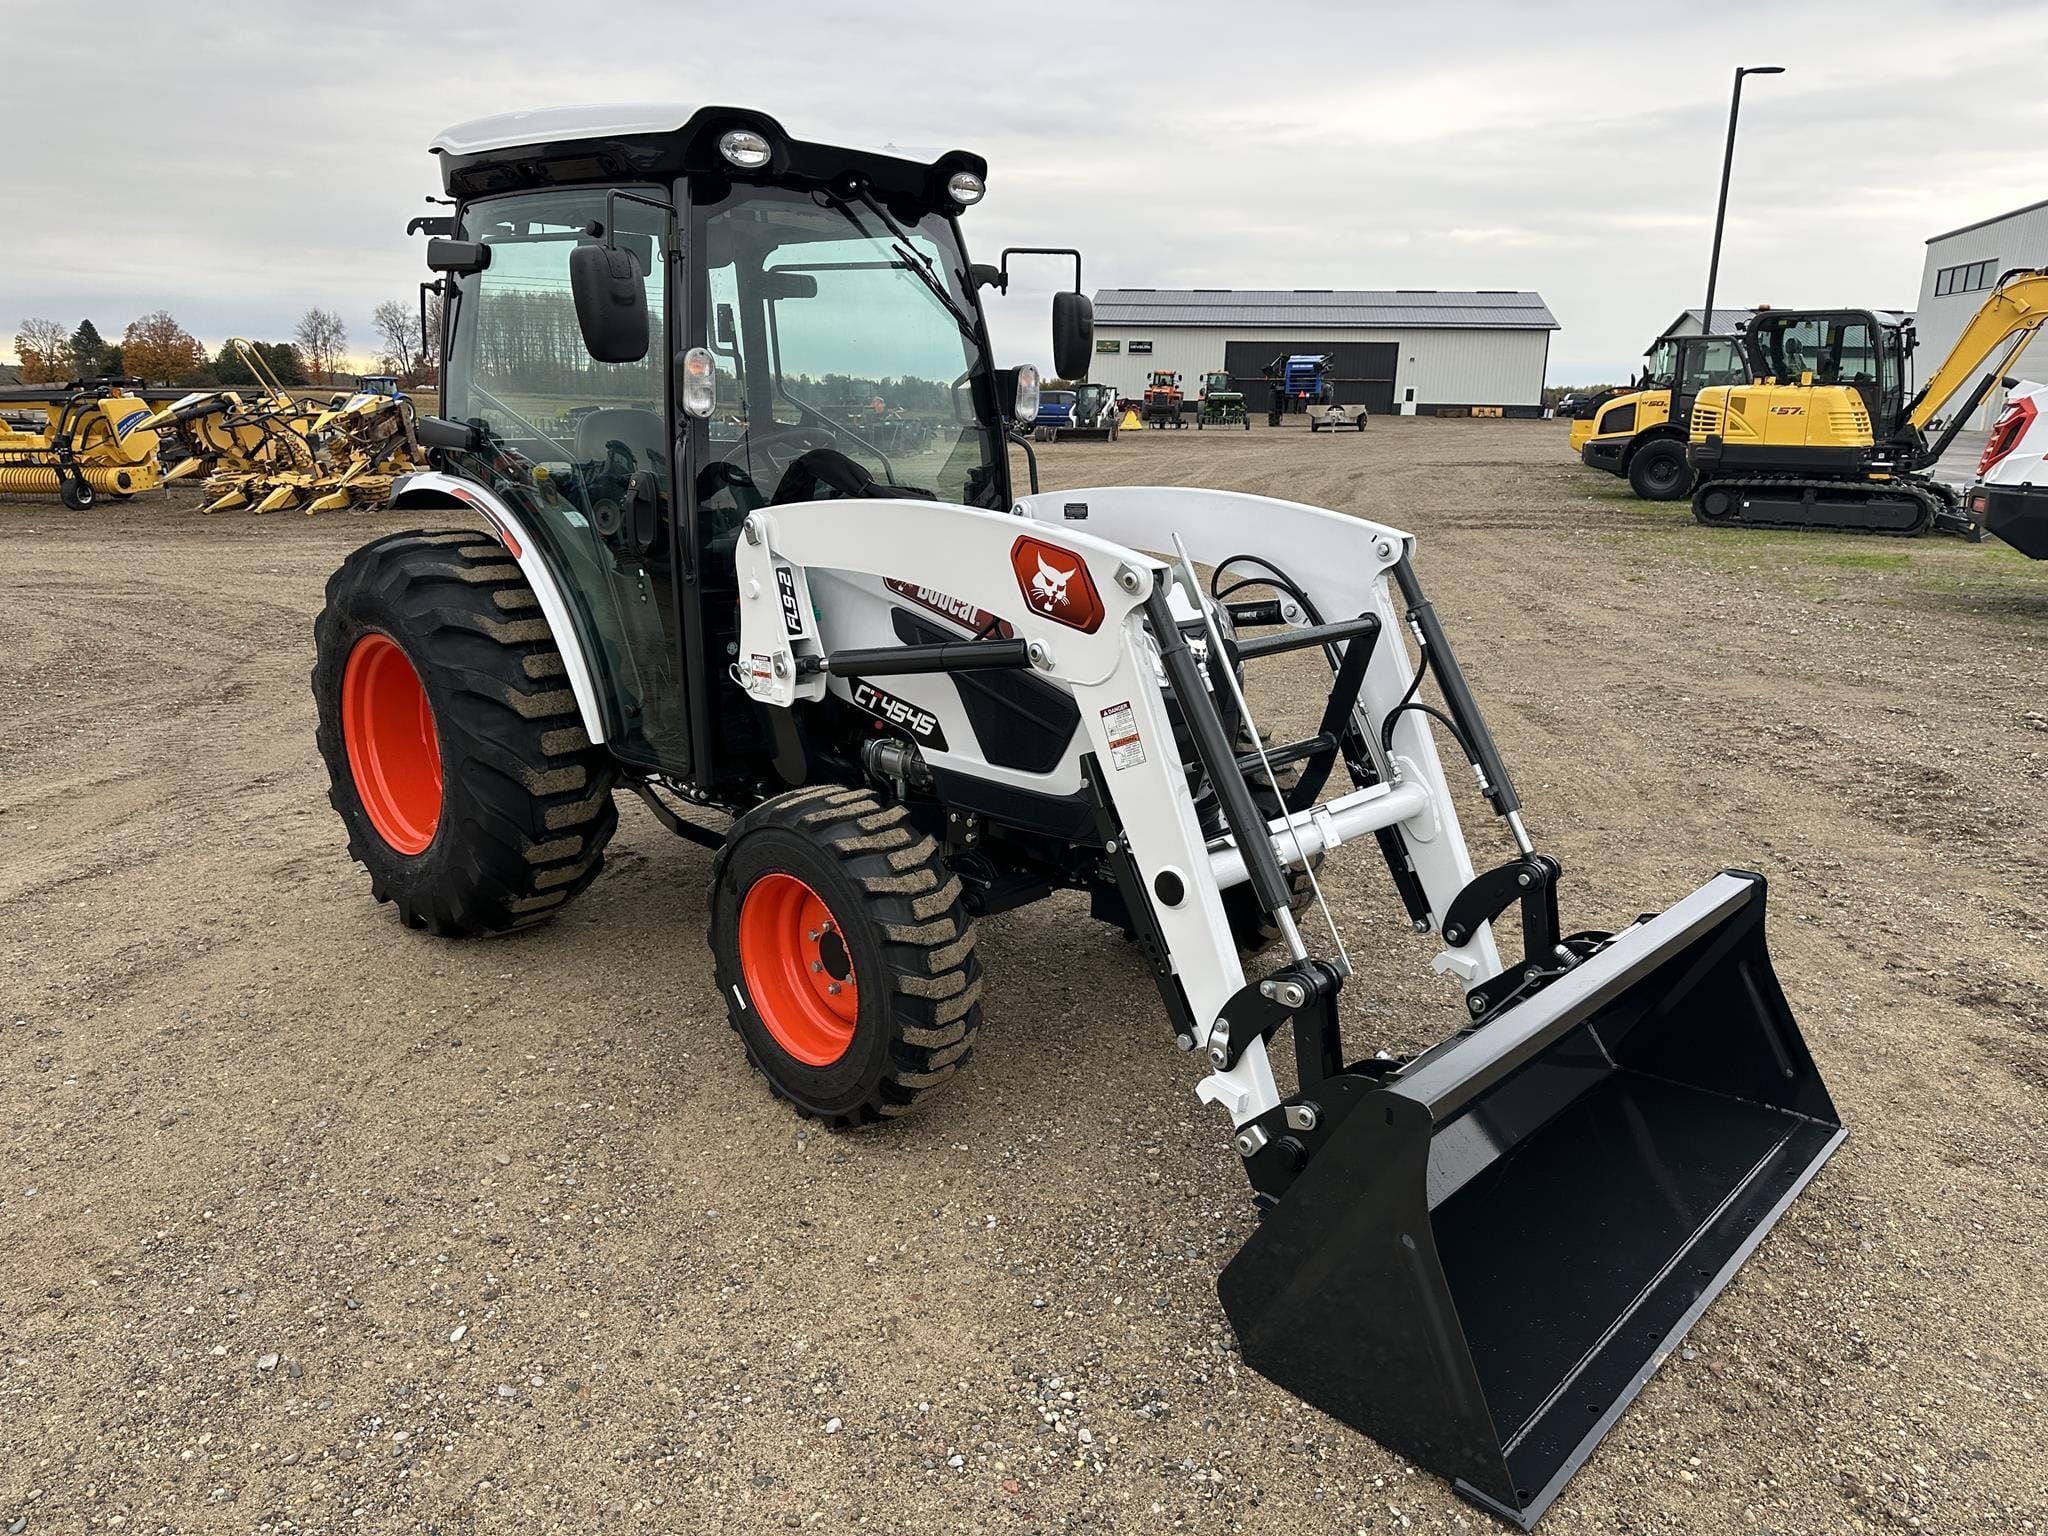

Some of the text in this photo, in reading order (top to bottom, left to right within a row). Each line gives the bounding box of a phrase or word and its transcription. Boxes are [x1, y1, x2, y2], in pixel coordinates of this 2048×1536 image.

[777, 571, 801, 631] FL9-2
[854, 684, 937, 736] CT4545
[1108, 704, 1128, 714] DANGER
